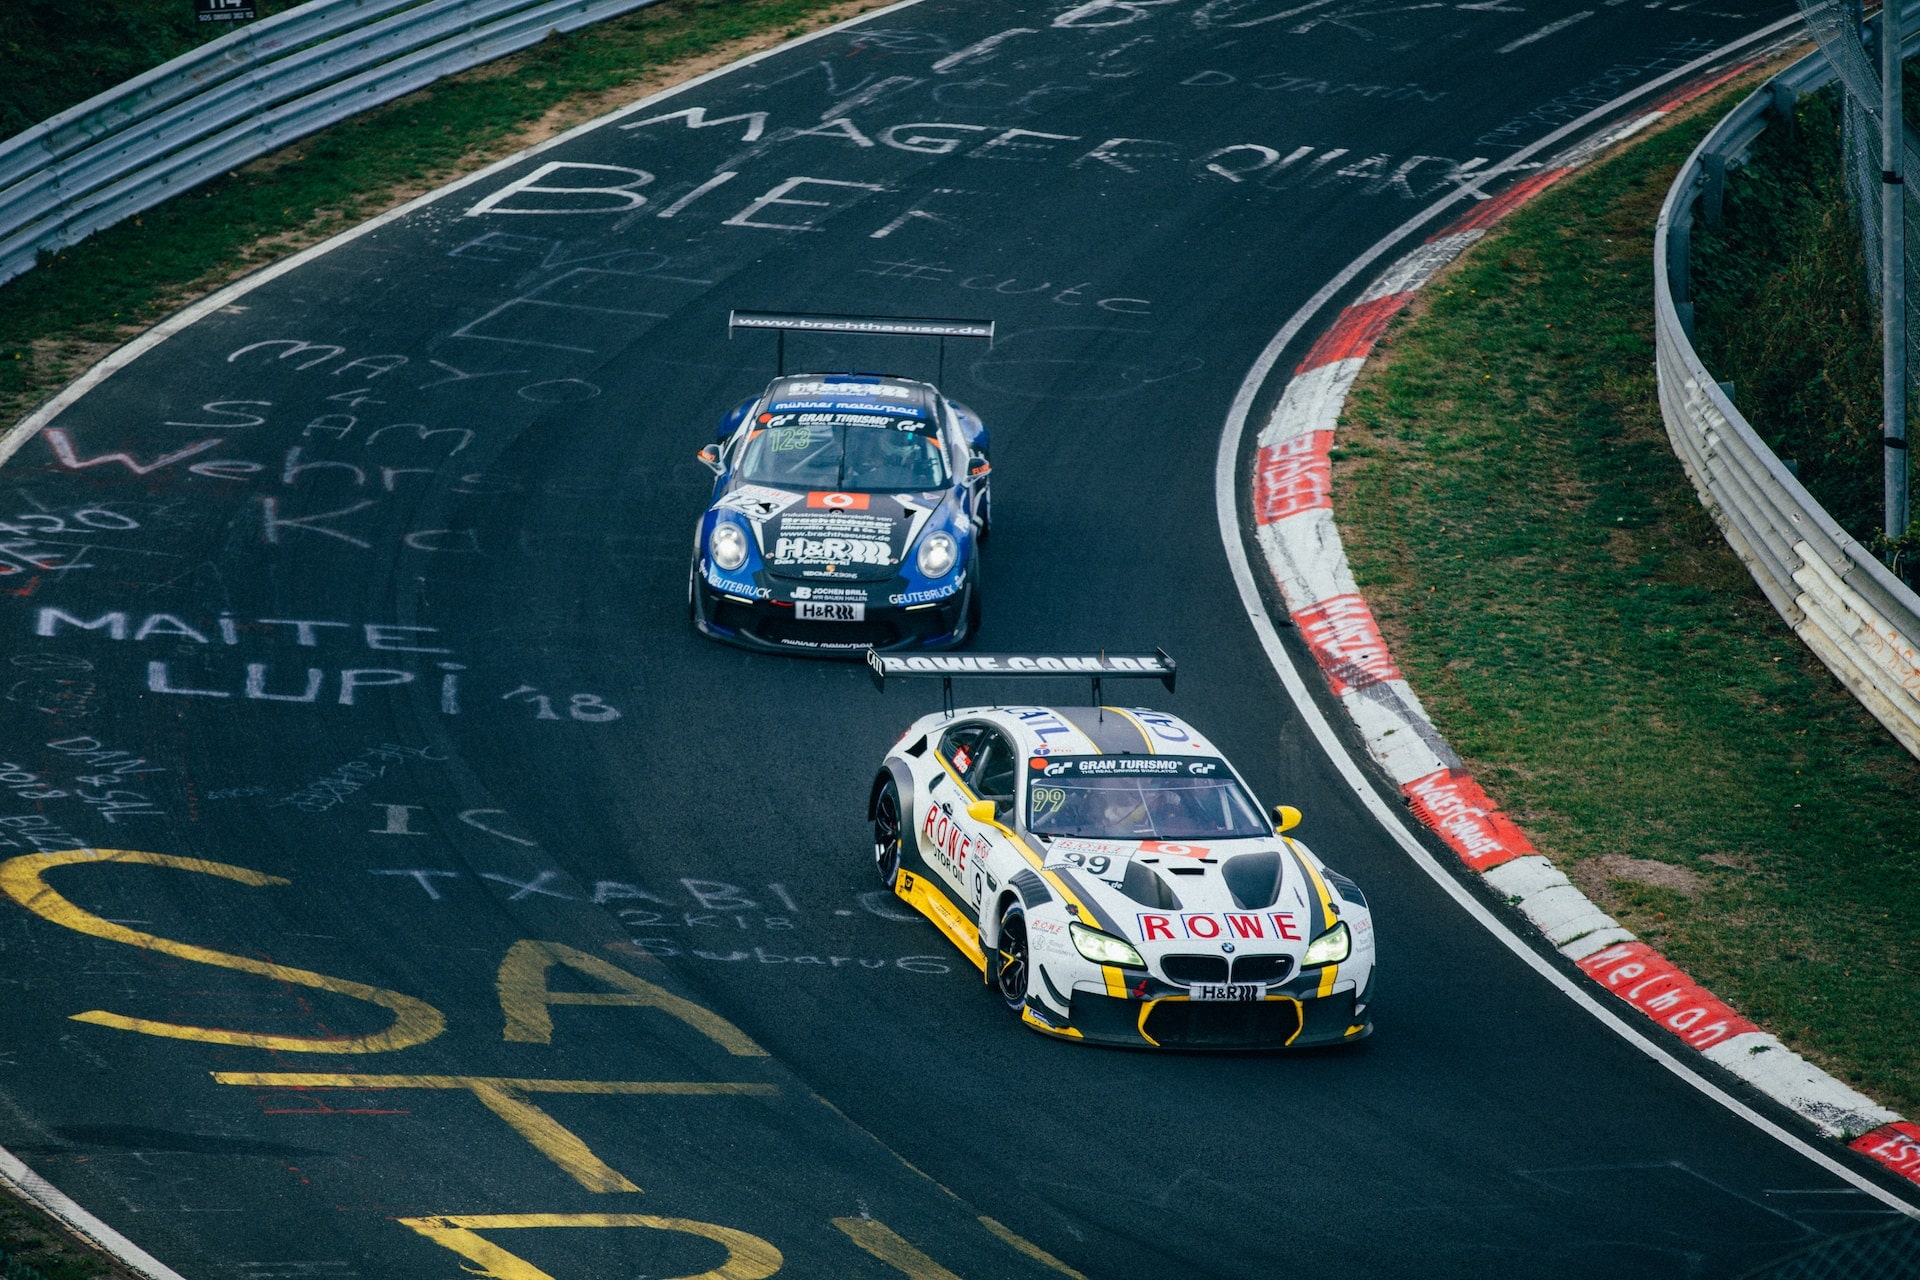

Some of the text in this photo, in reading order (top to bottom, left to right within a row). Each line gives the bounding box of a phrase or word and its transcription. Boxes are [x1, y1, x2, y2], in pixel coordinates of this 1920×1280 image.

[738, 318, 986, 335] www.brachthaeuser.de
[836, 403, 919, 416] motorsport
[798, 413, 835, 424] GRAN
[769, 427, 812, 452] 123
[780, 530, 891, 542] www.brachthaeuser.de
[812, 588, 869, 597] JOCHEN BRILL
[803, 603, 837, 619] H&R
[866, 649, 885, 677] CATL
[1078, 759, 1117, 771] GRAN
[1118, 760, 1178, 771] TURISMO
[1031, 787, 1067, 814] 99
[923, 803, 971, 872] ROWE
[1062, 852, 1111, 875] 99
[952, 862, 966, 887] OIL
[1032, 919, 1064, 934] ROWE
[1142, 913, 1302, 941] ROWE
[1203, 985, 1238, 1000] H&R
